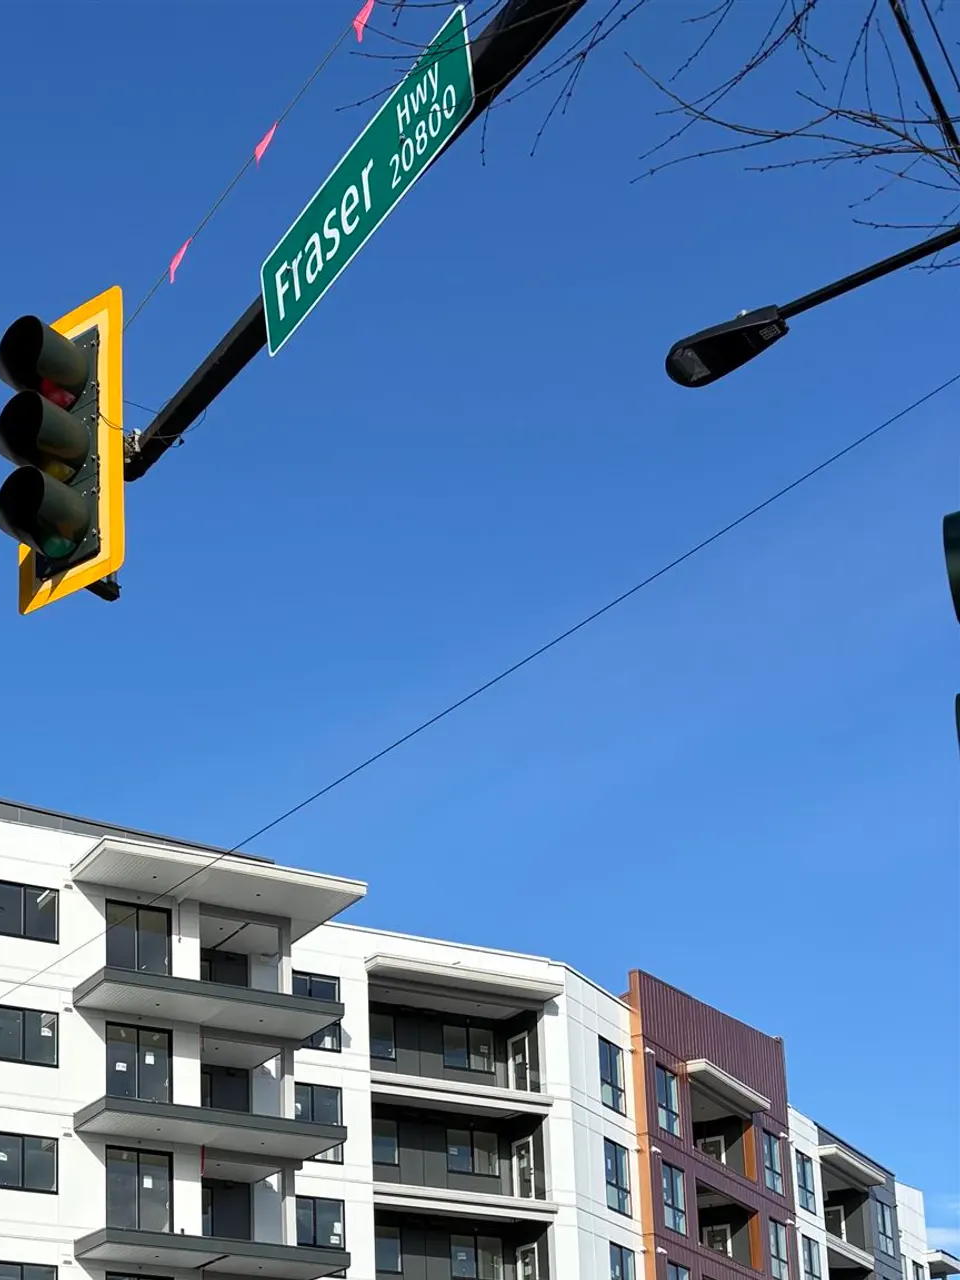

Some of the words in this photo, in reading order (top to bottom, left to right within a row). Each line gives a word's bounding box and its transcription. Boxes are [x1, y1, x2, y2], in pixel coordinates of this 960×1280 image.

[274, 157, 374, 321] Fraser
[395, 61, 439, 134] Hwy
[389, 84, 456, 190] 20800
